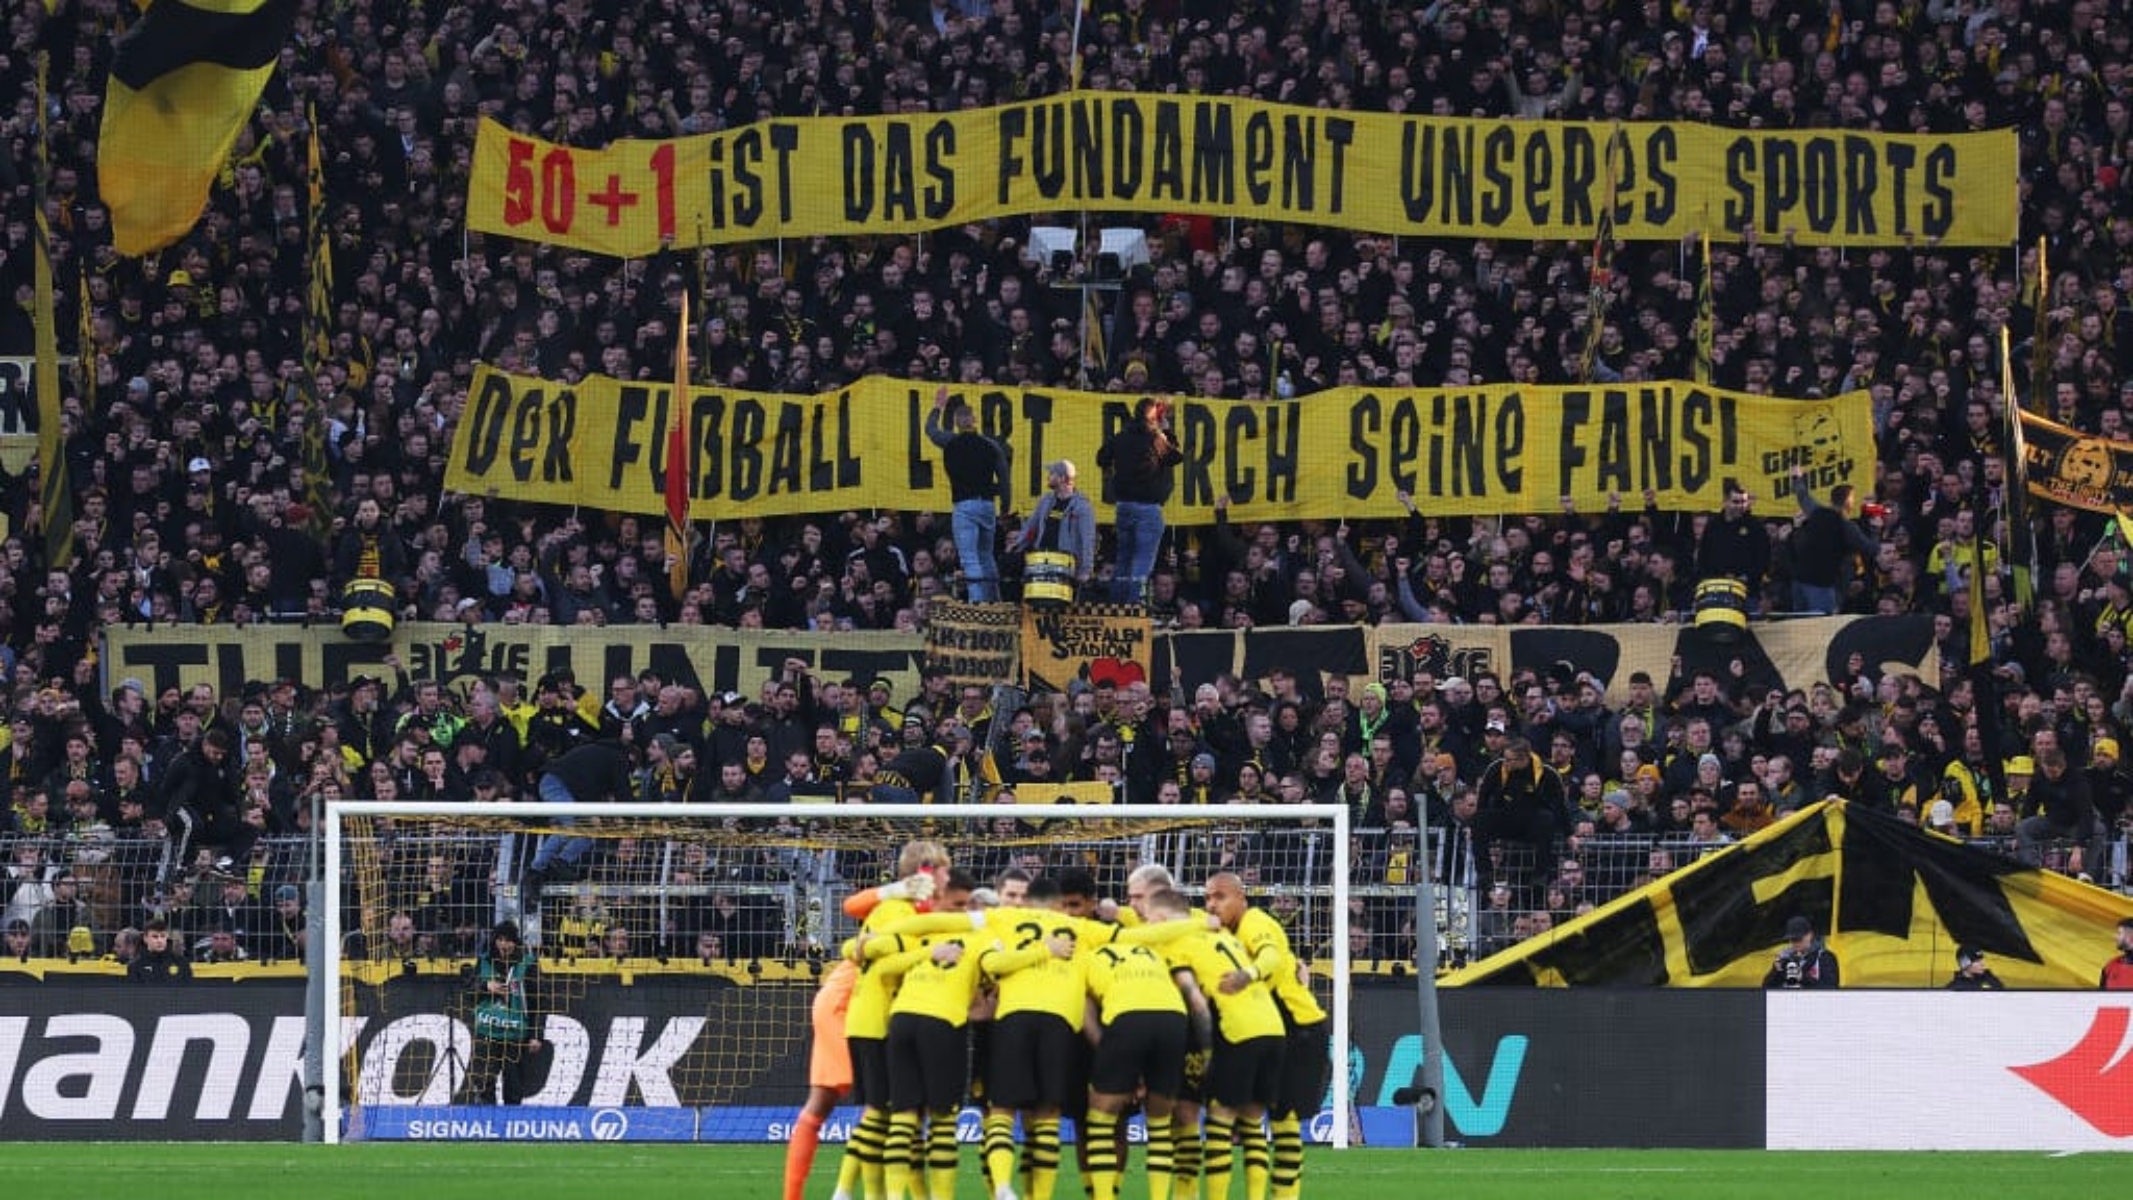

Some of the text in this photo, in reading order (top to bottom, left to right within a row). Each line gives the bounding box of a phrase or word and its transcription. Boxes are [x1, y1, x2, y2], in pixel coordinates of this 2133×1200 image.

[503, 138, 676, 241] 50+1
[843, 119, 957, 223] DAS
[1724, 134, 1957, 237] SPORTS
[408, 1120, 582, 1139] SIGNAL IDUNA
